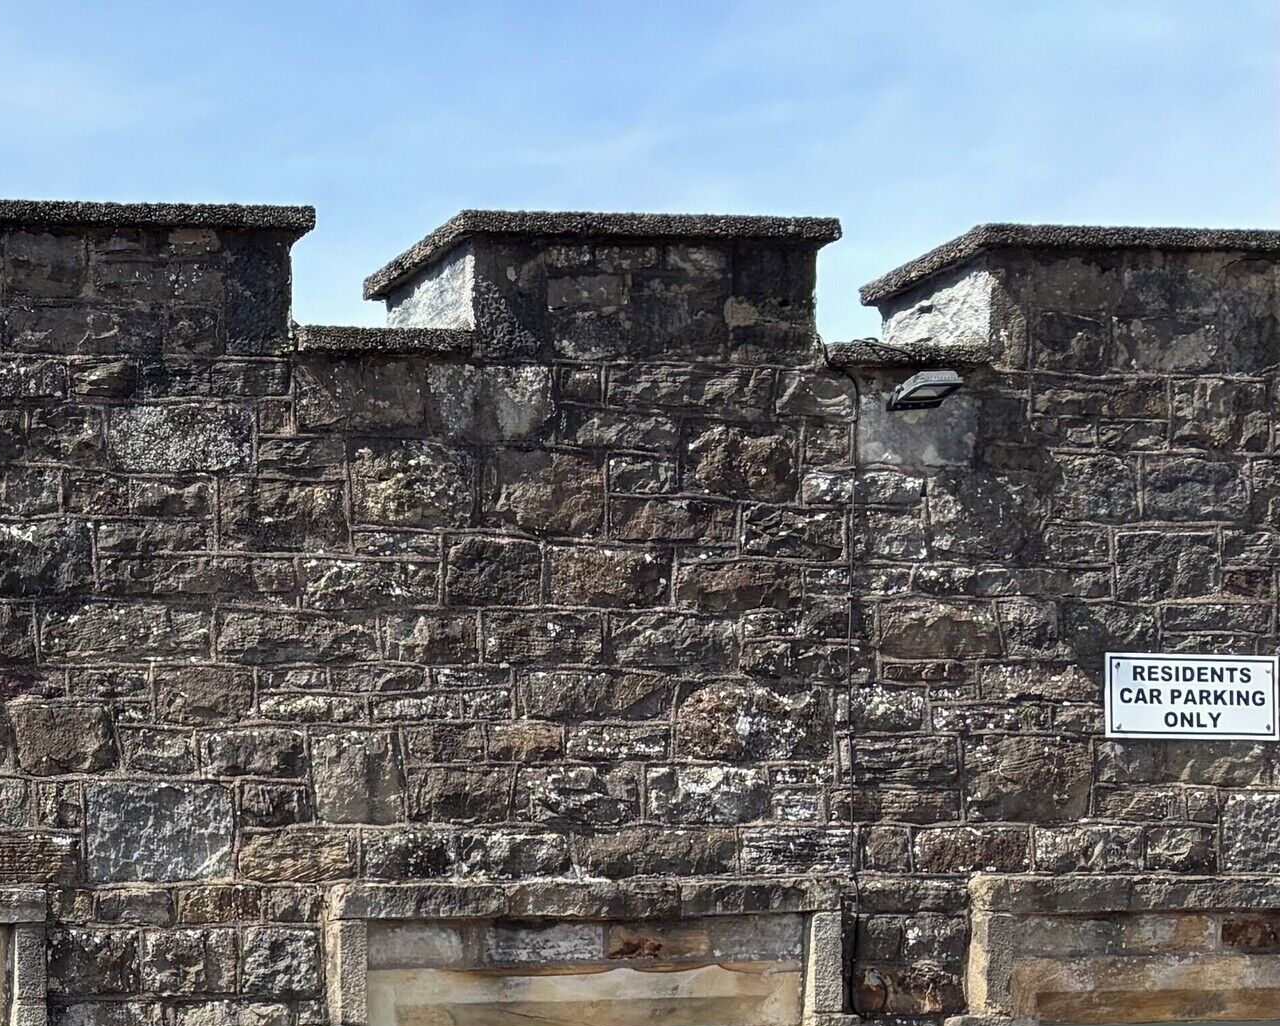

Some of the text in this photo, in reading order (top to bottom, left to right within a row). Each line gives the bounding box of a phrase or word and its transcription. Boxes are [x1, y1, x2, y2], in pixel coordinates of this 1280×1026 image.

[1132, 665, 1252, 684] RESIDENTS
[1119, 687, 1266, 707] CAR PARKING
[1163, 711, 1222, 729] ONLY
